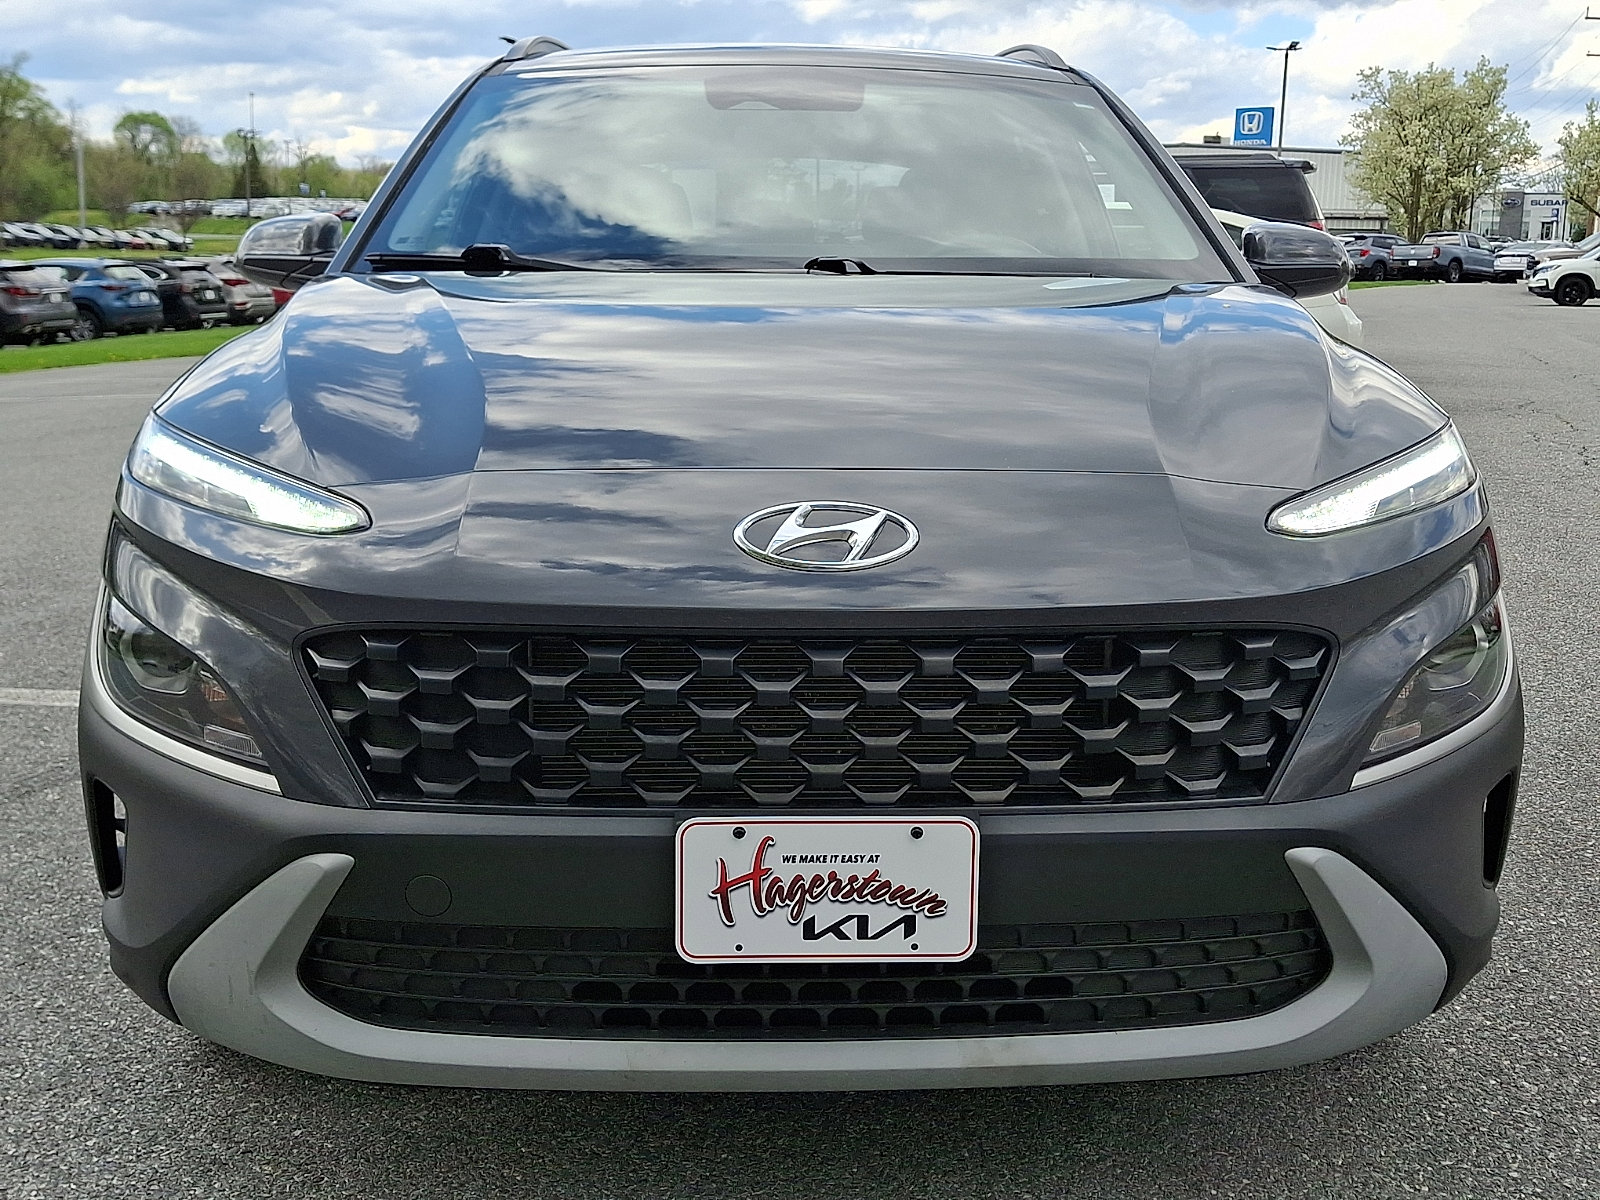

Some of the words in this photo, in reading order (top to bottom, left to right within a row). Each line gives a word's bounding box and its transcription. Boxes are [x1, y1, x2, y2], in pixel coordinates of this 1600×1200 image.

[782, 854, 797, 864] WE
[798, 854, 828, 864] MAKE
[829, 854, 840, 864] IT
[840, 854, 866, 864] EASY
[866, 854, 880, 864] AT
[710, 836, 948, 926] Hagerstown
[802, 915, 917, 941] KIA
